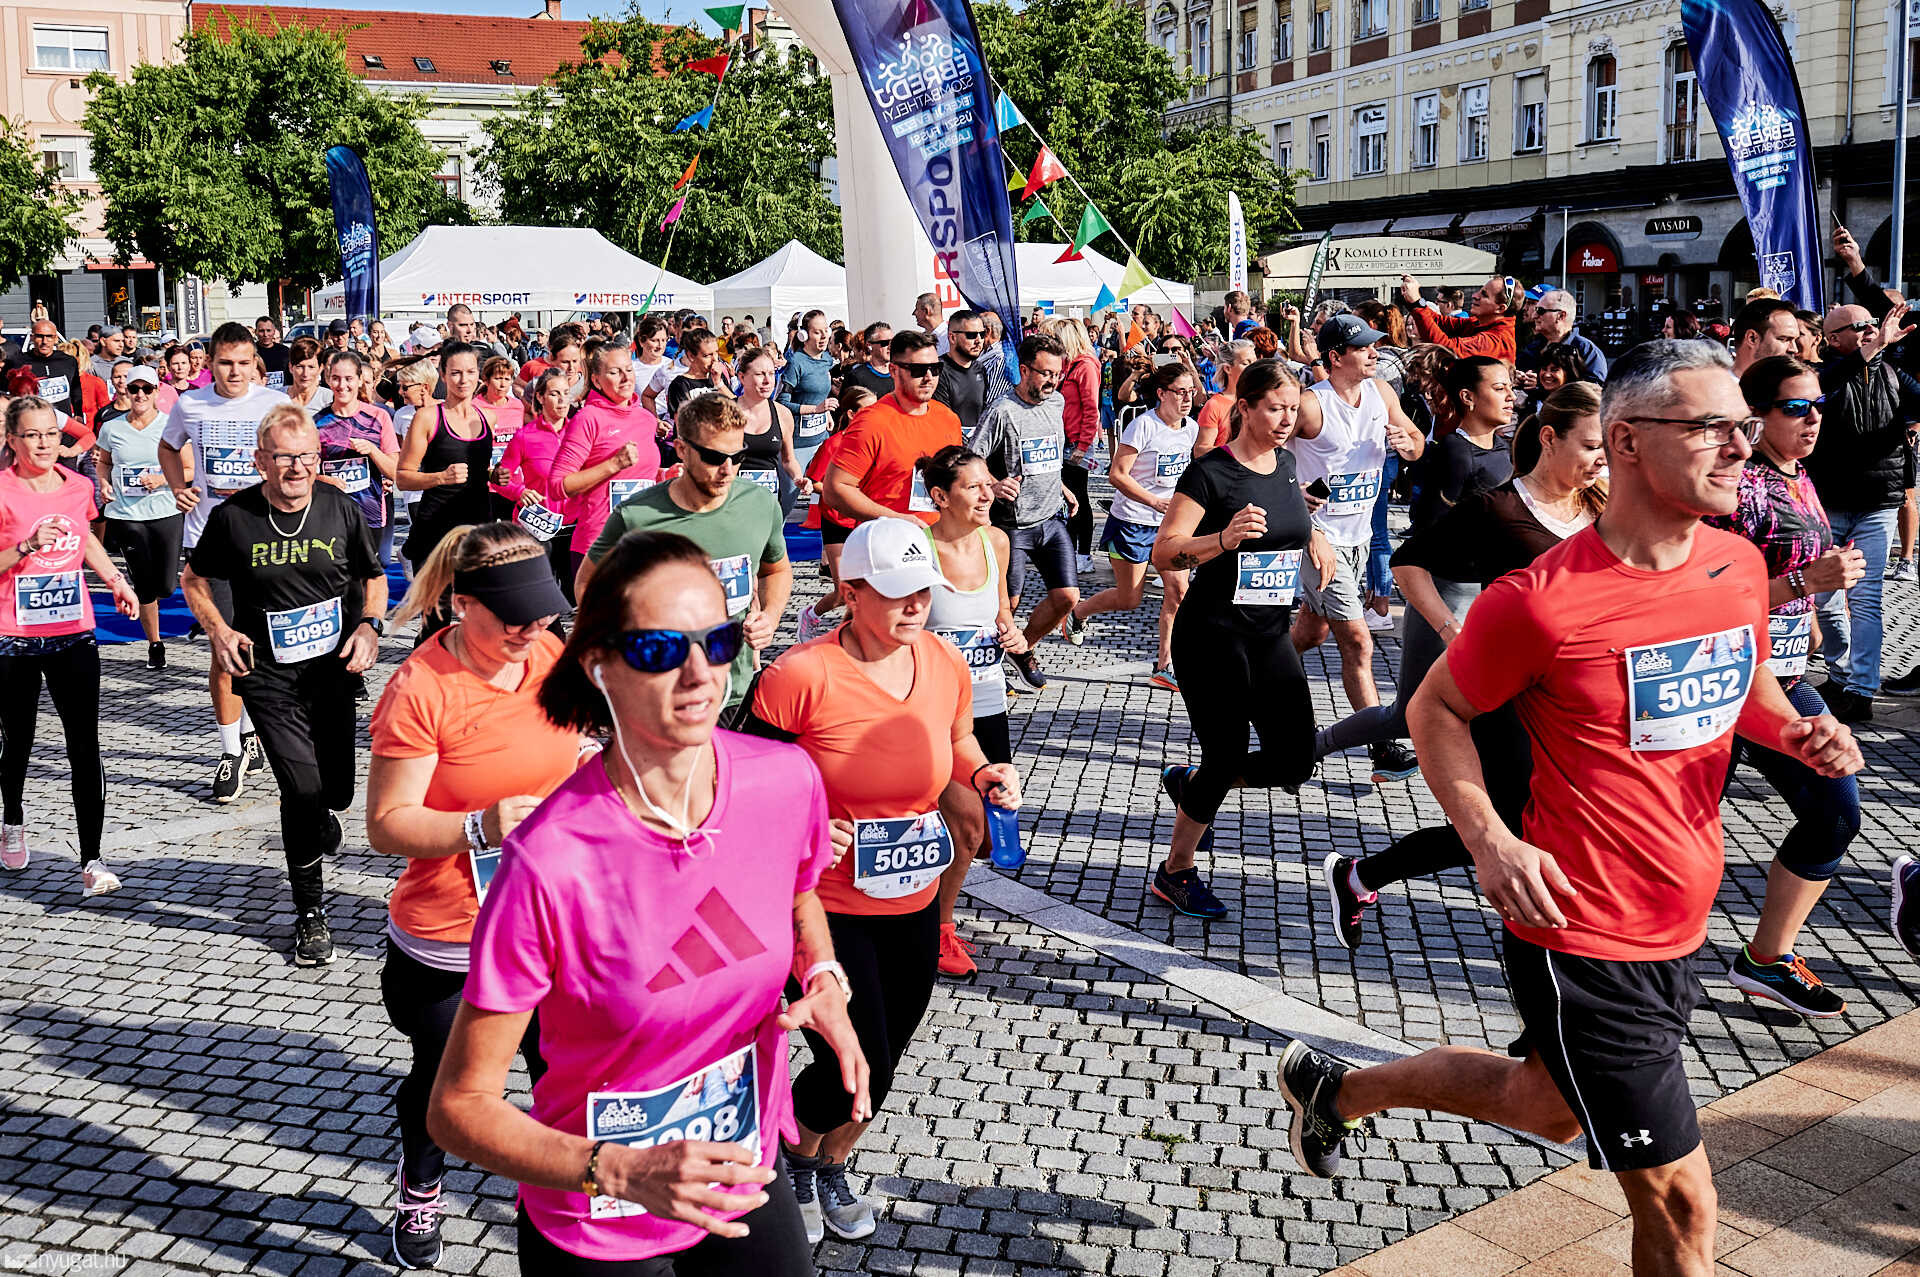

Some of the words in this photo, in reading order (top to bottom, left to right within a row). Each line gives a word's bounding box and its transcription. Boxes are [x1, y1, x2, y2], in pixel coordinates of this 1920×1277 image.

[1654, 220, 1690, 231] VASADI
[1345, 245, 1388, 258] KOMLÓ
[1392, 244, 1443, 257] ÉTTEREM
[1345, 262, 1364, 270] PIZZA
[437, 292, 531, 306] INTERSPORT
[589, 293, 674, 306] INTERSPORT
[41, 385, 65, 396] 5073
[1029, 448, 1057, 462] 5040
[212, 460, 254, 475] 5059
[1338, 484, 1375, 501] 5118
[525, 513, 556, 534] 5092
[251, 539, 309, 567] RUN
[901, 555, 928, 563] adidas
[1250, 570, 1297, 588] 5087
[29, 589, 75, 608] 5047
[284, 620, 334, 646] 5099
[1771, 635, 1810, 656] 5109
[960, 648, 996, 665] 088
[1658, 668, 1741, 712] 5052
[874, 842, 941, 872] 5036
